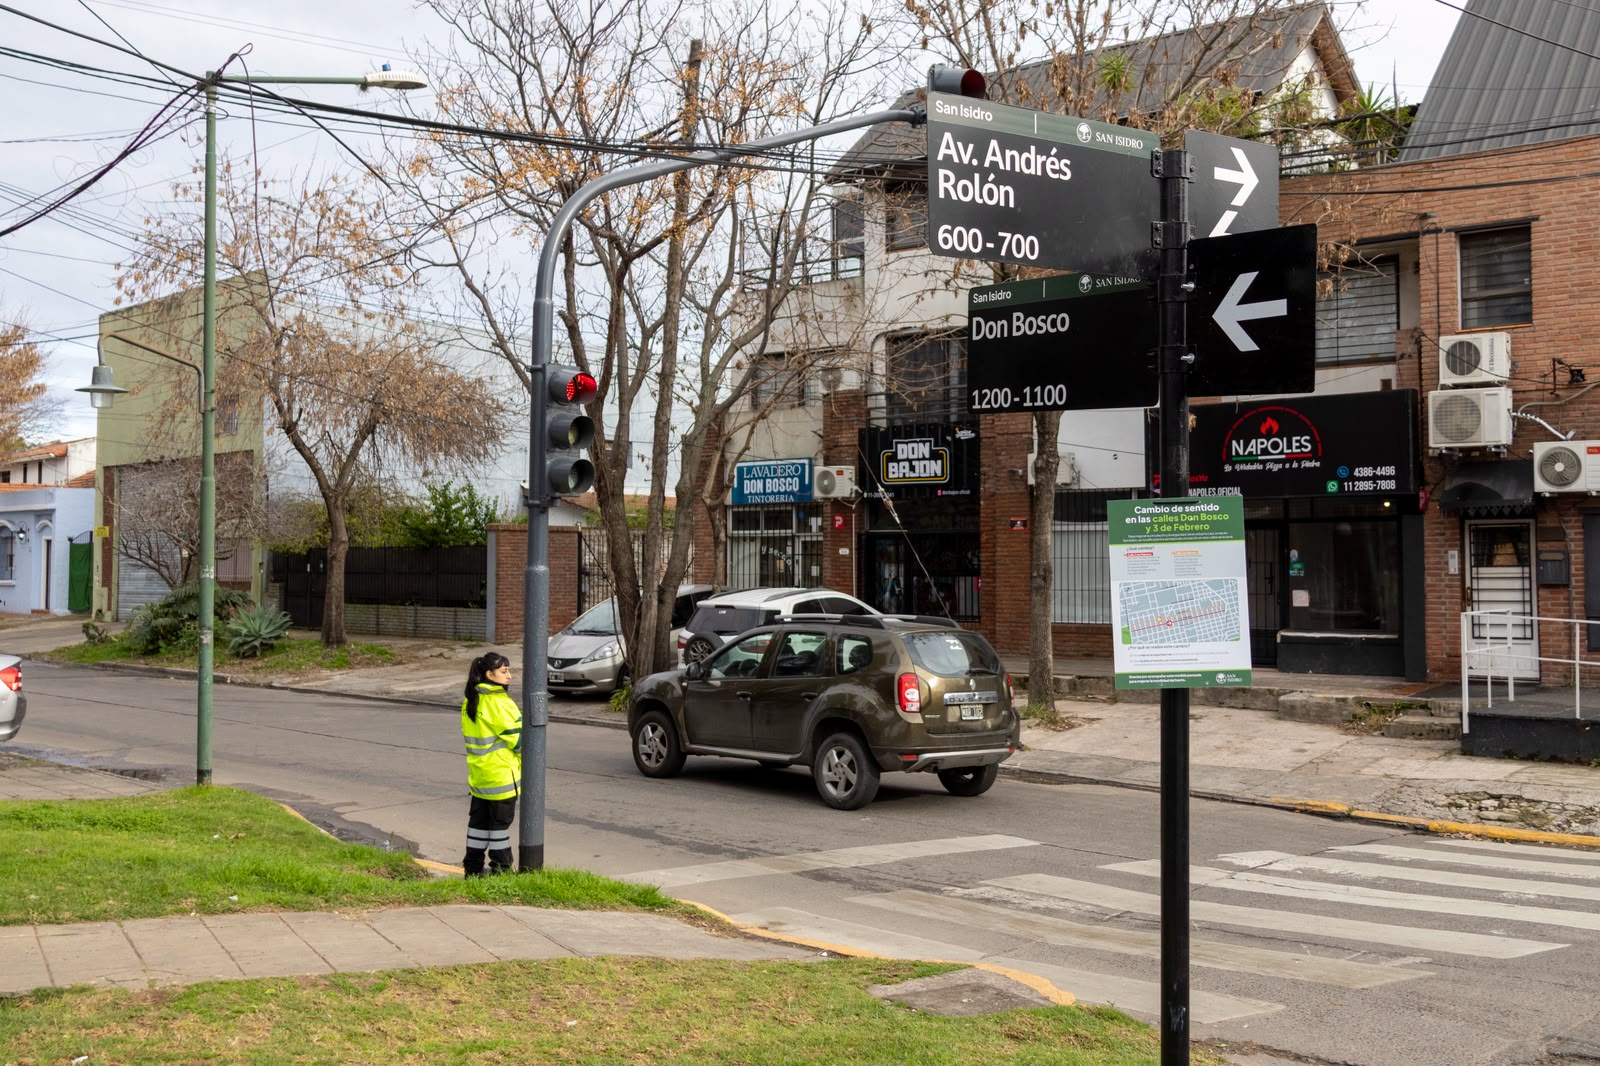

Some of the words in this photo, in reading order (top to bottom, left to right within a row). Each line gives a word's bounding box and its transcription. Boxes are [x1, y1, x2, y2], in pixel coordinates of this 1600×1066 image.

[936, 100, 957, 116] San
[960, 106, 992, 122] Isidro
[1096, 132, 1113, 144] SAN
[1115, 136, 1144, 150] ISIDRO
[937, 132, 978, 166] Av.
[984, 139, 1072, 180] Andrés
[938, 168, 1014, 208] Rolón
[1096, 278, 1112, 288] SAN
[973, 293, 988, 303] San
[988, 290, 1012, 302] Isidro
[972, 316, 1008, 340] Don
[1012, 312, 1070, 336] Bosco
[897, 442, 930, 460] DON
[1232, 436, 1312, 456] NAPOLES
[744, 464, 802, 478] LAVADERO
[888, 460, 942, 478] BAJON
[1266, 462, 1282, 472] Pizza
[1353, 466, 1396, 477] 4386-4496
[744, 479, 763, 494] DON
[766, 477, 799, 493] BOSCO
[1344, 482, 1352, 491] 11
[1354, 480, 1396, 491] 2895-7808
[747, 495, 794, 503] TINTORERIA
[1134, 506, 1170, 514] Cambio
[1185, 504, 1220, 512] sentido
